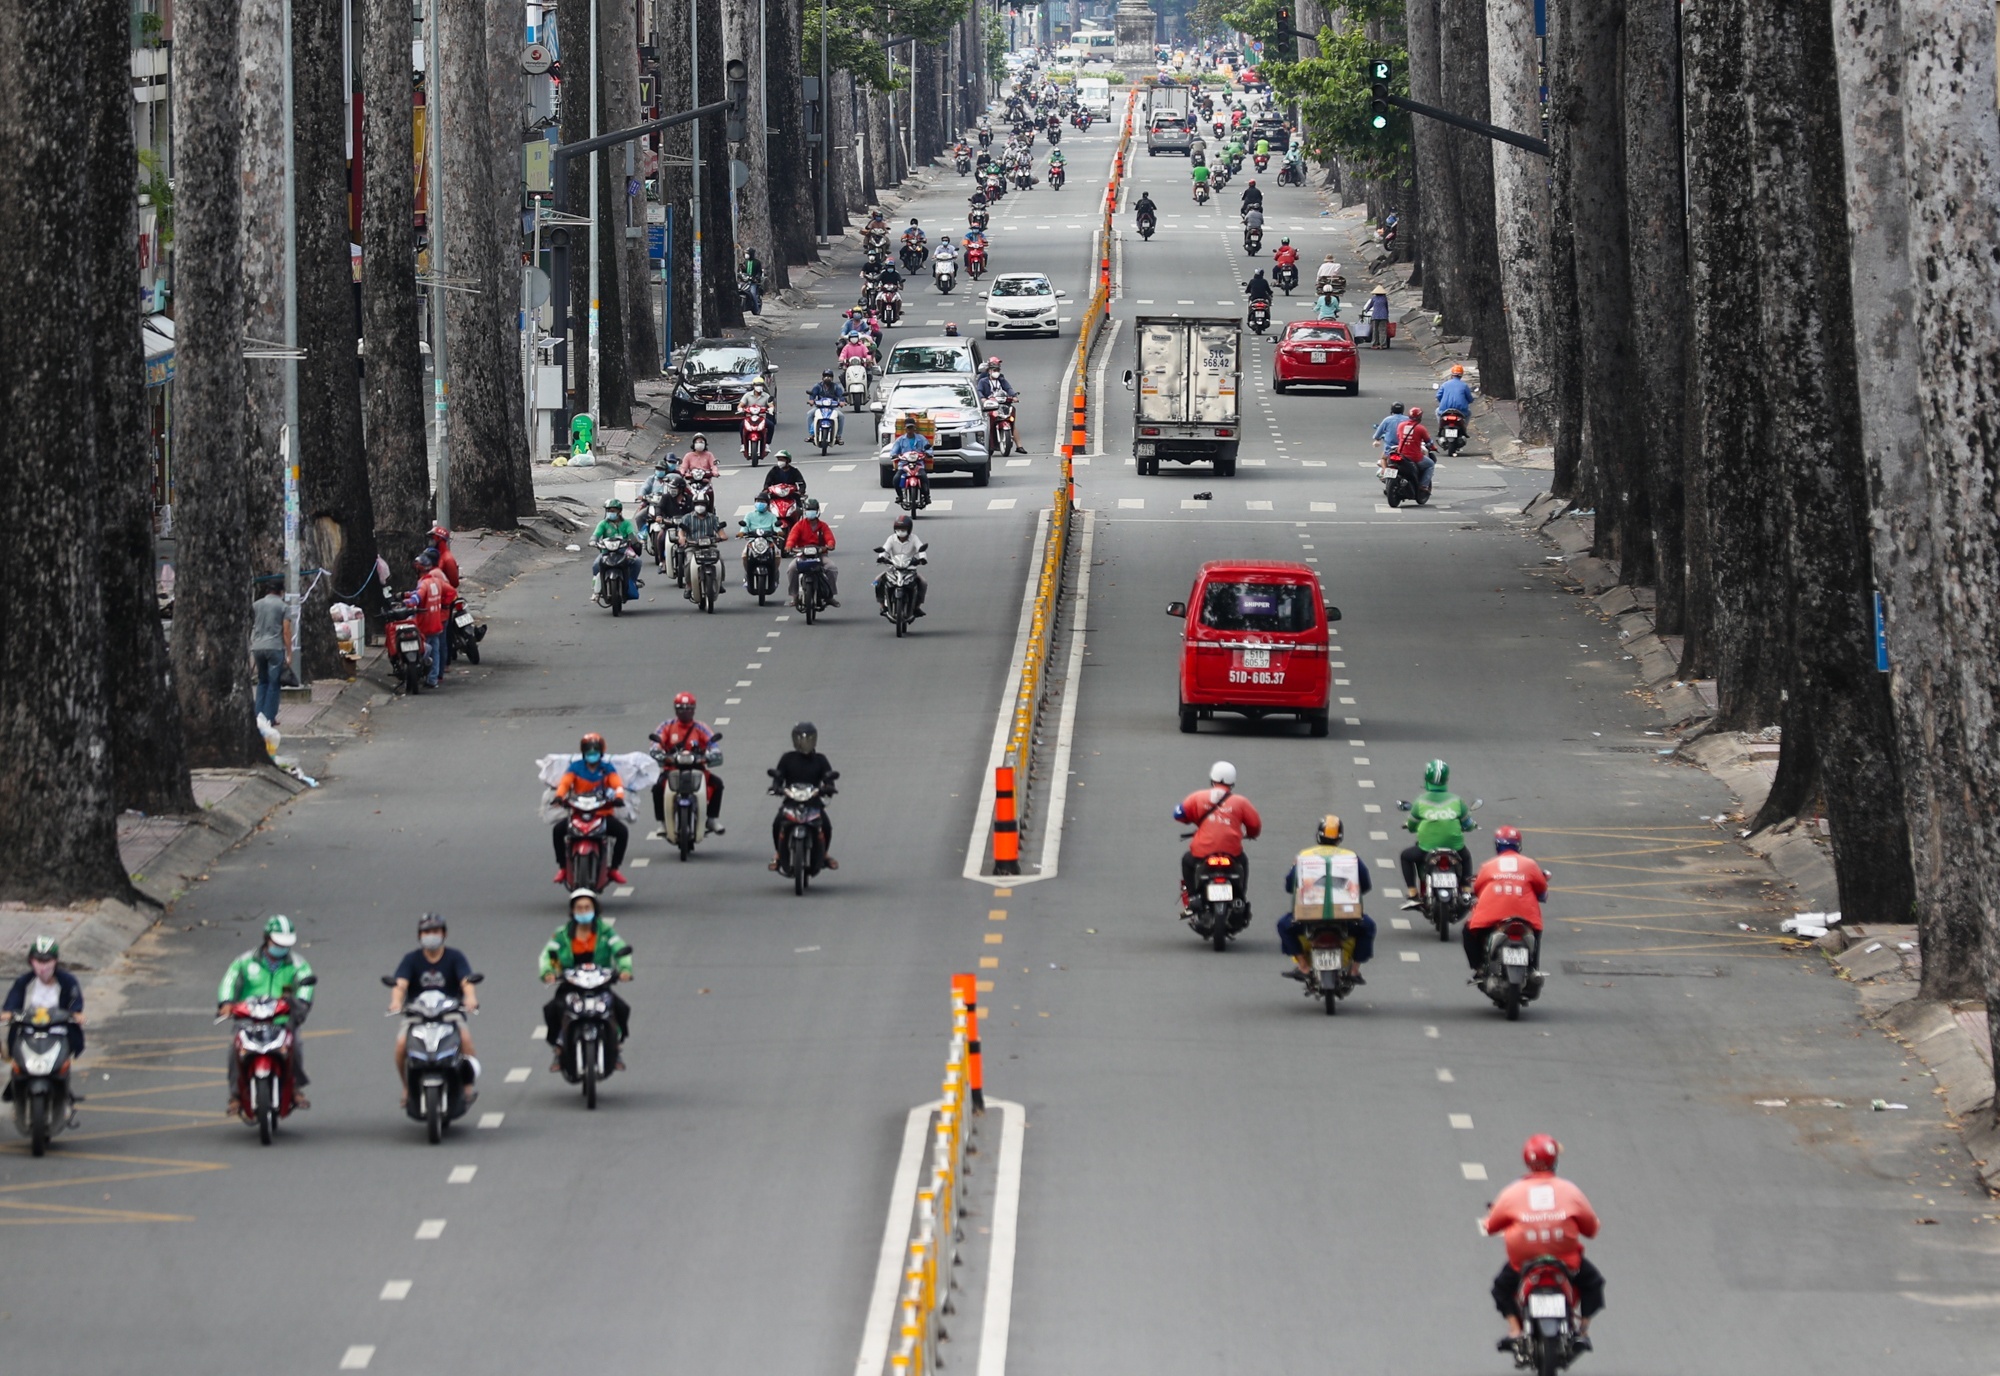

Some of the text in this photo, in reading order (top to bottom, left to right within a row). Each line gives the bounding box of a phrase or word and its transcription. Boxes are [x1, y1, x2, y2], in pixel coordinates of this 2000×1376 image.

[1209, 350, 1224, 358] 51C
[1203, 358, 1229, 368] 568.42
[1250, 650, 1264, 658] 51D
[1244, 658, 1269, 667] 605.37
[1229, 670, 1285, 684] 51D-605.37
[1425, 808, 1457, 821] Grab
[1522, 1210, 1567, 1222] NowFood
